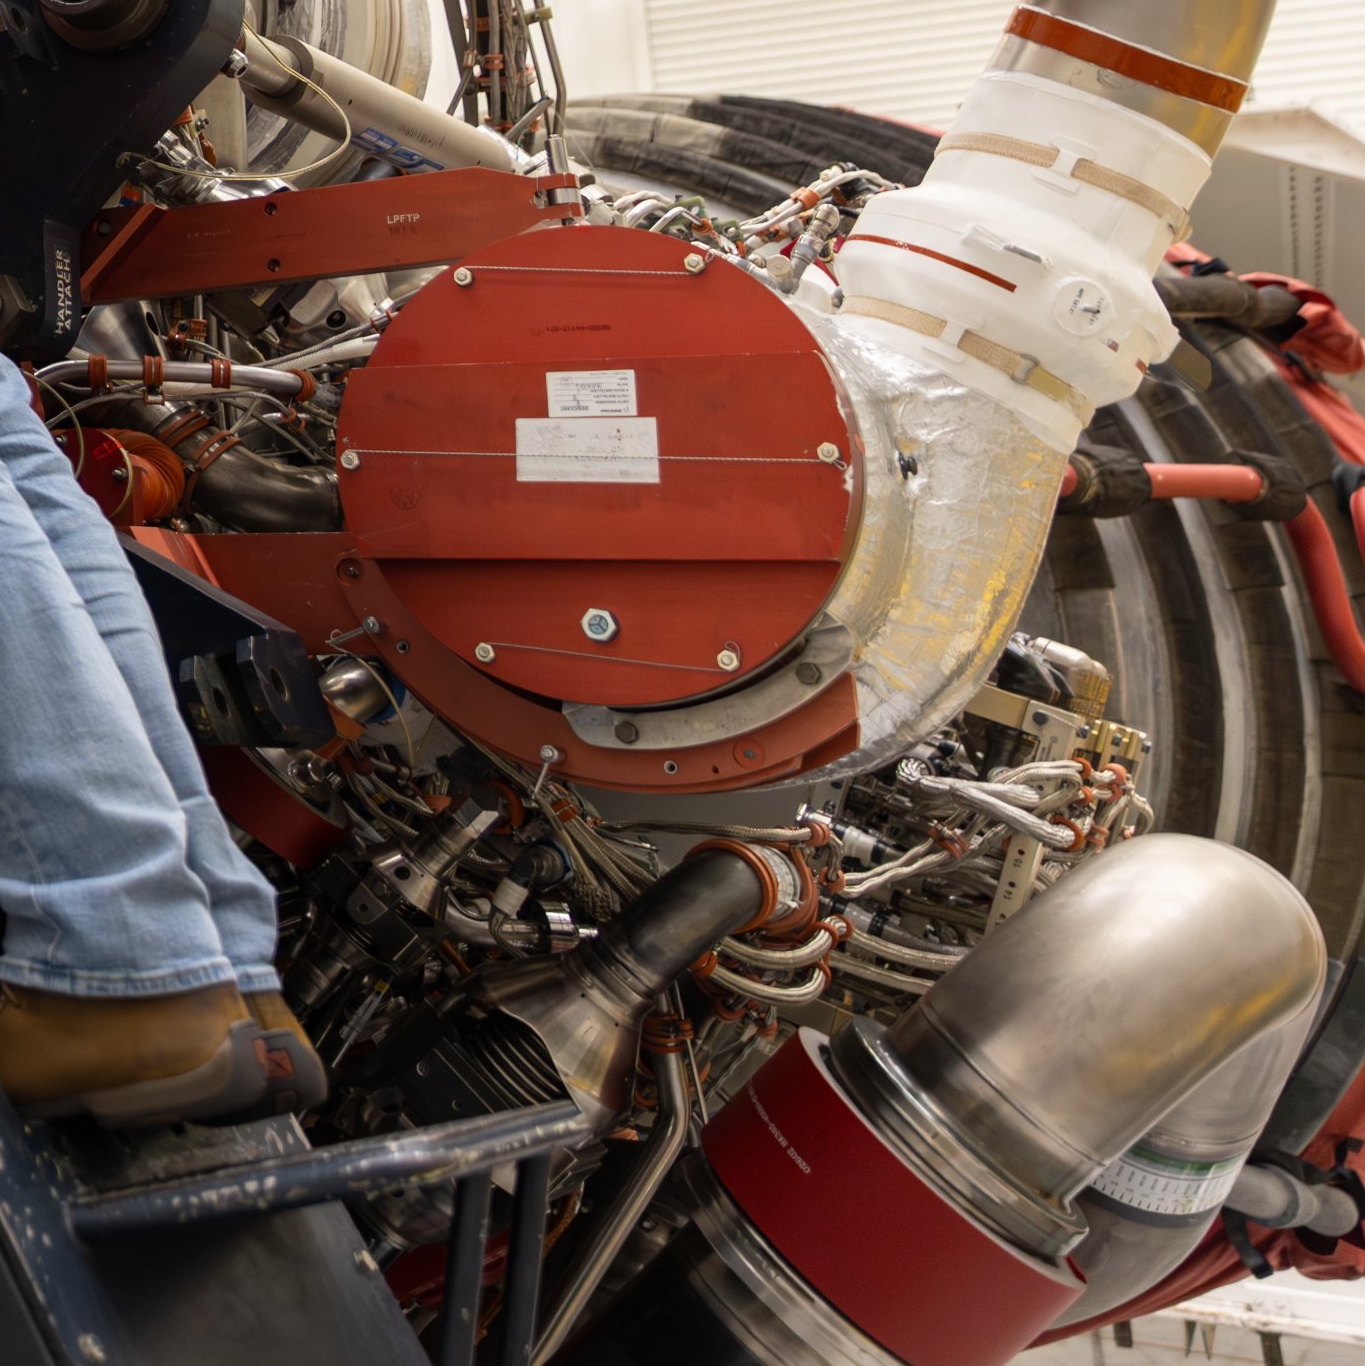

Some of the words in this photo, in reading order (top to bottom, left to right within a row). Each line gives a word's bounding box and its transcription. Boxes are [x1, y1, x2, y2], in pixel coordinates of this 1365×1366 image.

[386, 213, 420, 224] LPFTP
[54, 249, 65, 334] HANDLER
[64, 258, 73, 331] ATTACH
[1012, 857, 1024, 869] 15
[1003, 889, 1014, 901] 14
